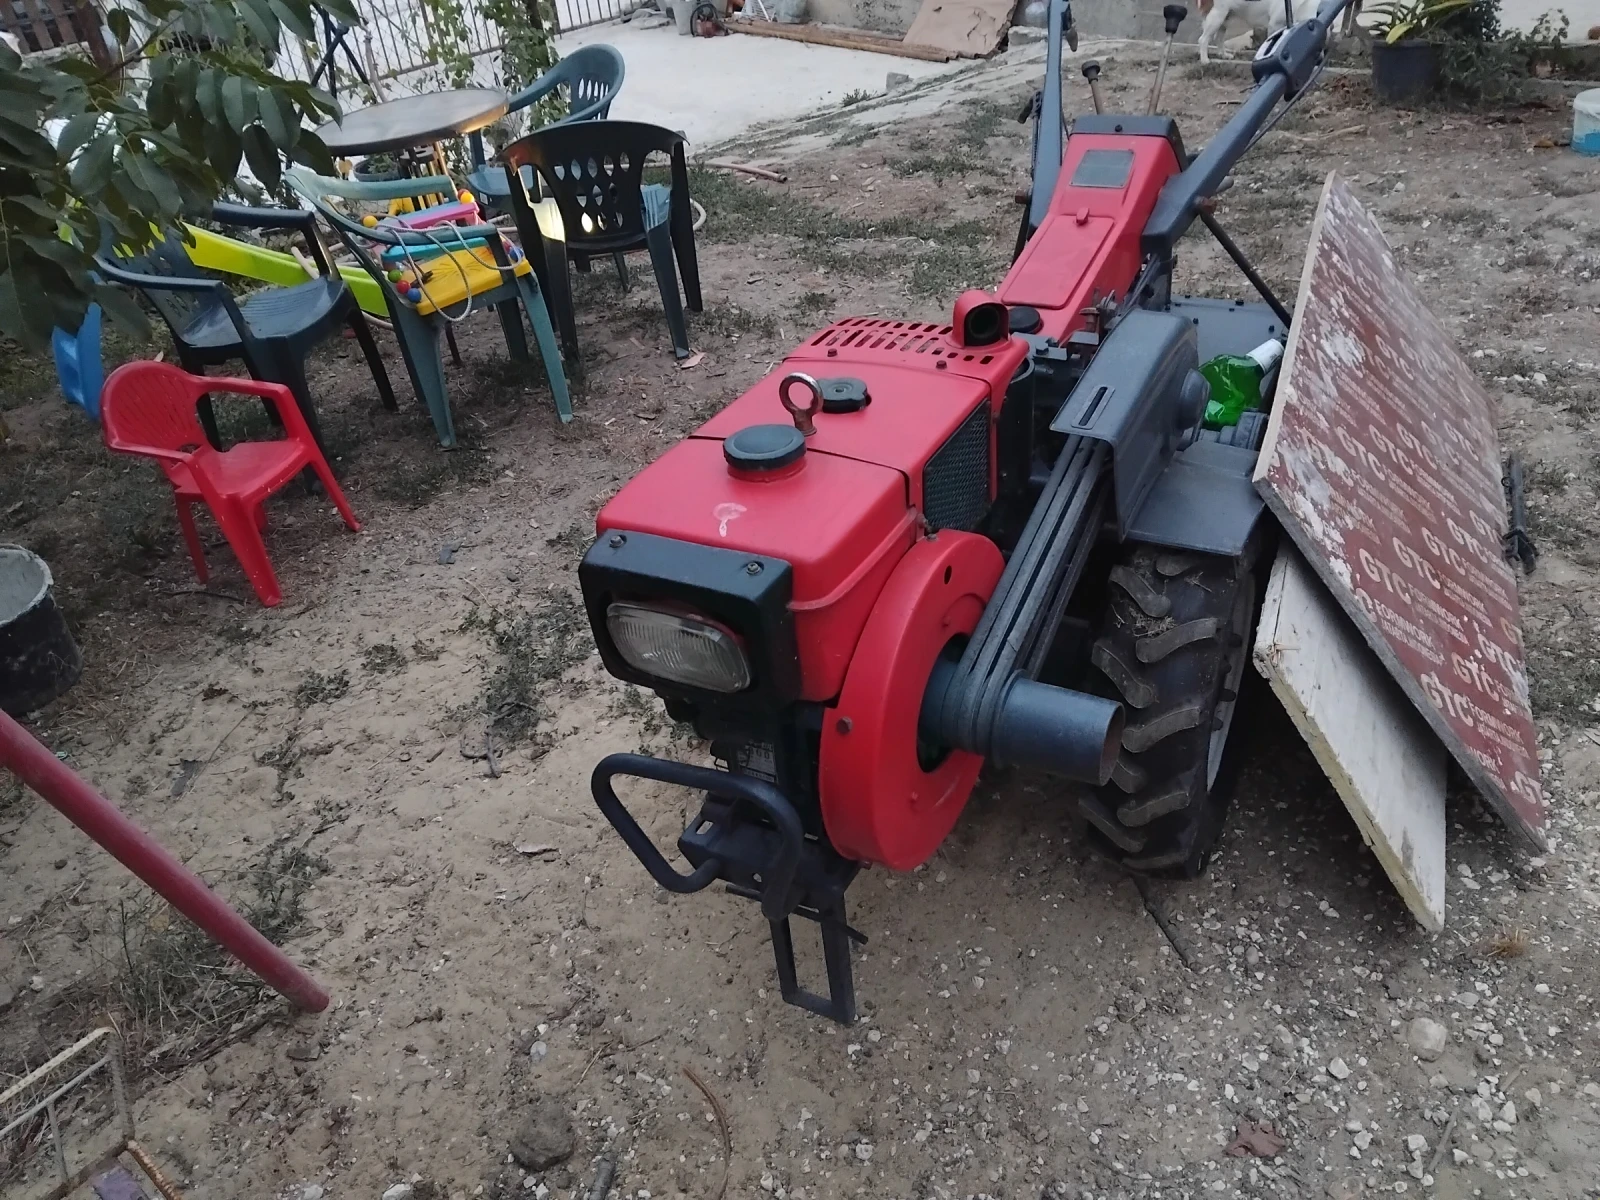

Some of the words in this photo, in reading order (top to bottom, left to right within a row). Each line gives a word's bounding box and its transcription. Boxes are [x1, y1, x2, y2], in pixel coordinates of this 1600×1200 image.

[1375, 334, 1414, 380] GTC
[1337, 426, 1386, 481] GTC
[1369, 424, 1413, 475] GTC
[1396, 422, 1437, 470] GTC
[1443, 420, 1479, 461] GTC
[1392, 536, 1441, 590] GTC
[1421, 526, 1466, 576] GTC
[1446, 517, 1488, 564] GTC
[1359, 548, 1412, 605] GTC
[1421, 672, 1474, 727] GTC
[1451, 652, 1499, 702] GTC
